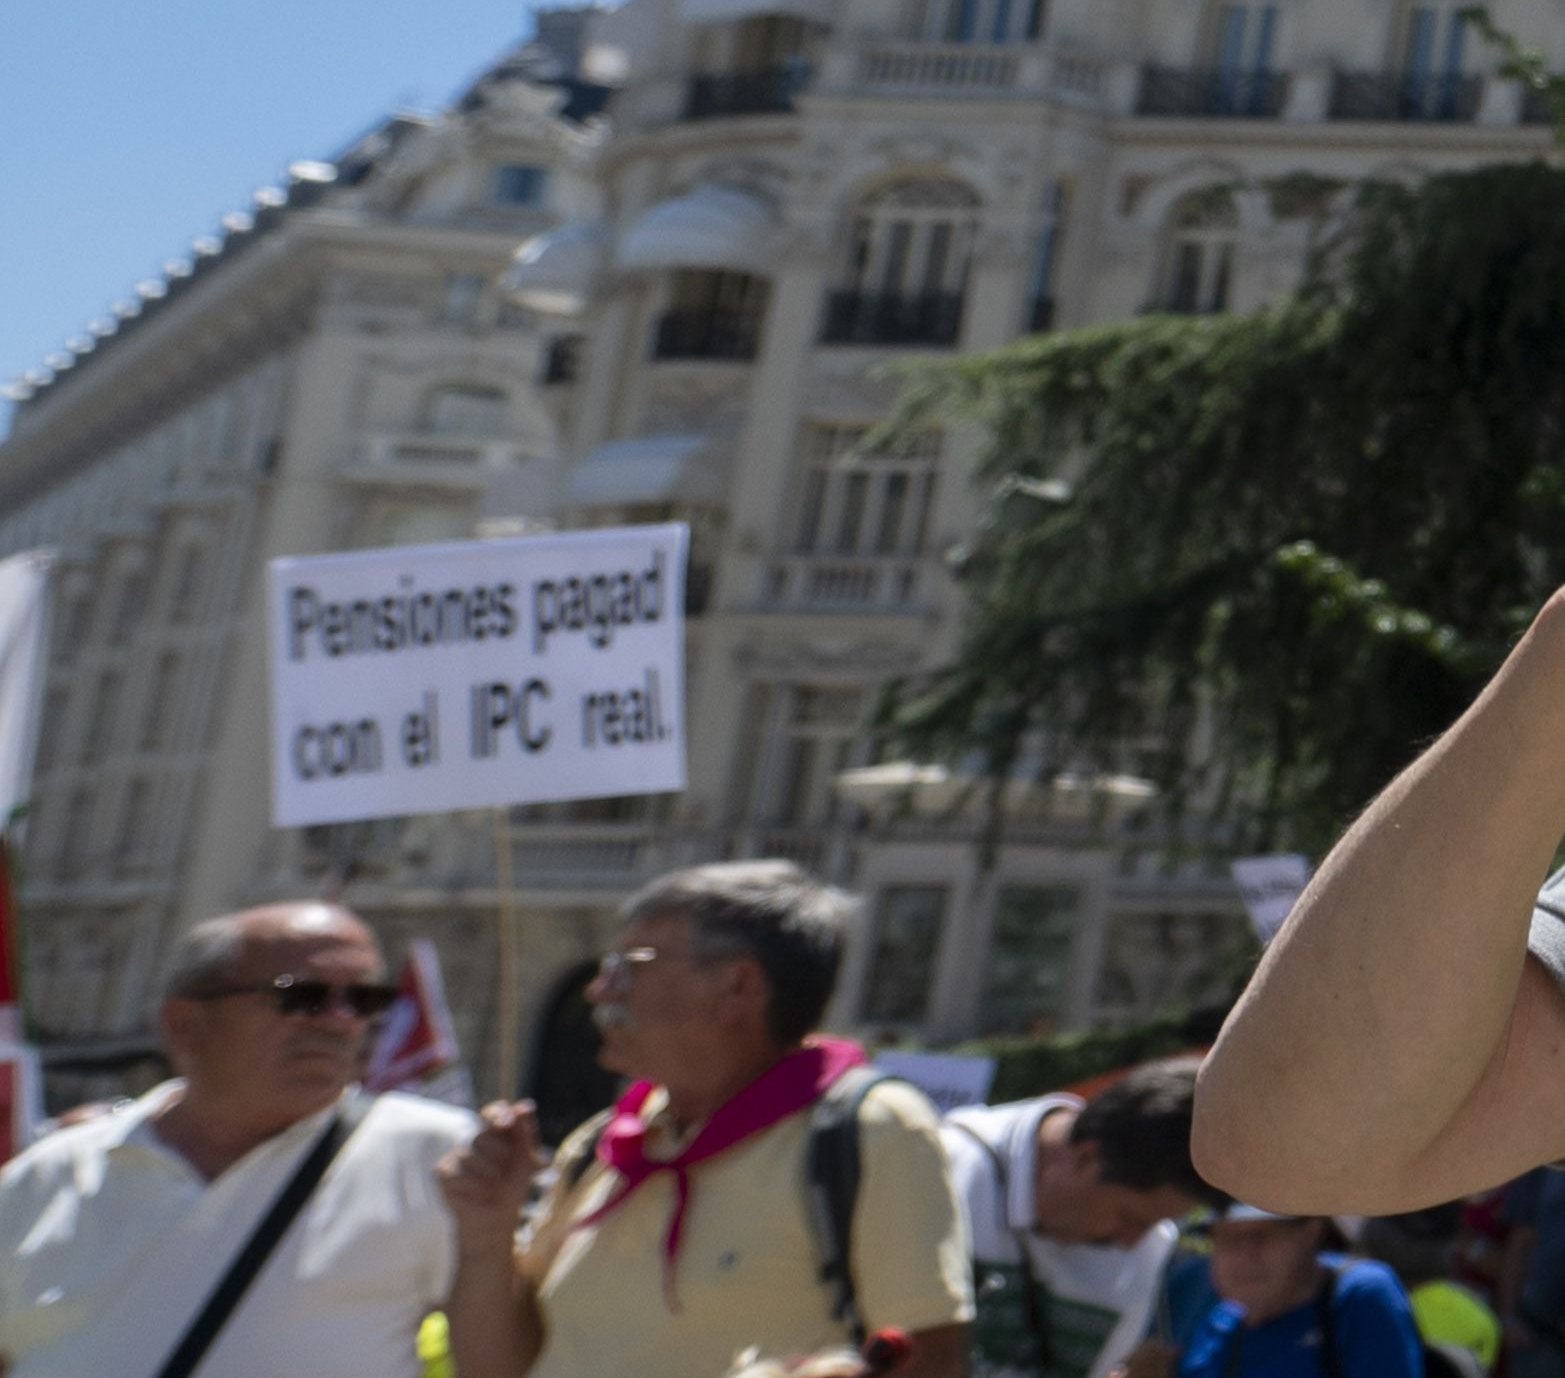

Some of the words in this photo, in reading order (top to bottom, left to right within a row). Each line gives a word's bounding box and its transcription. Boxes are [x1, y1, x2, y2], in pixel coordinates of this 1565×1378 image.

[286, 574, 517, 662] Pensiones
[532, 547, 667, 654] pagad
[292, 718, 384, 780] con
[402, 688, 440, 769] el
[470, 677, 553, 760] IPC
